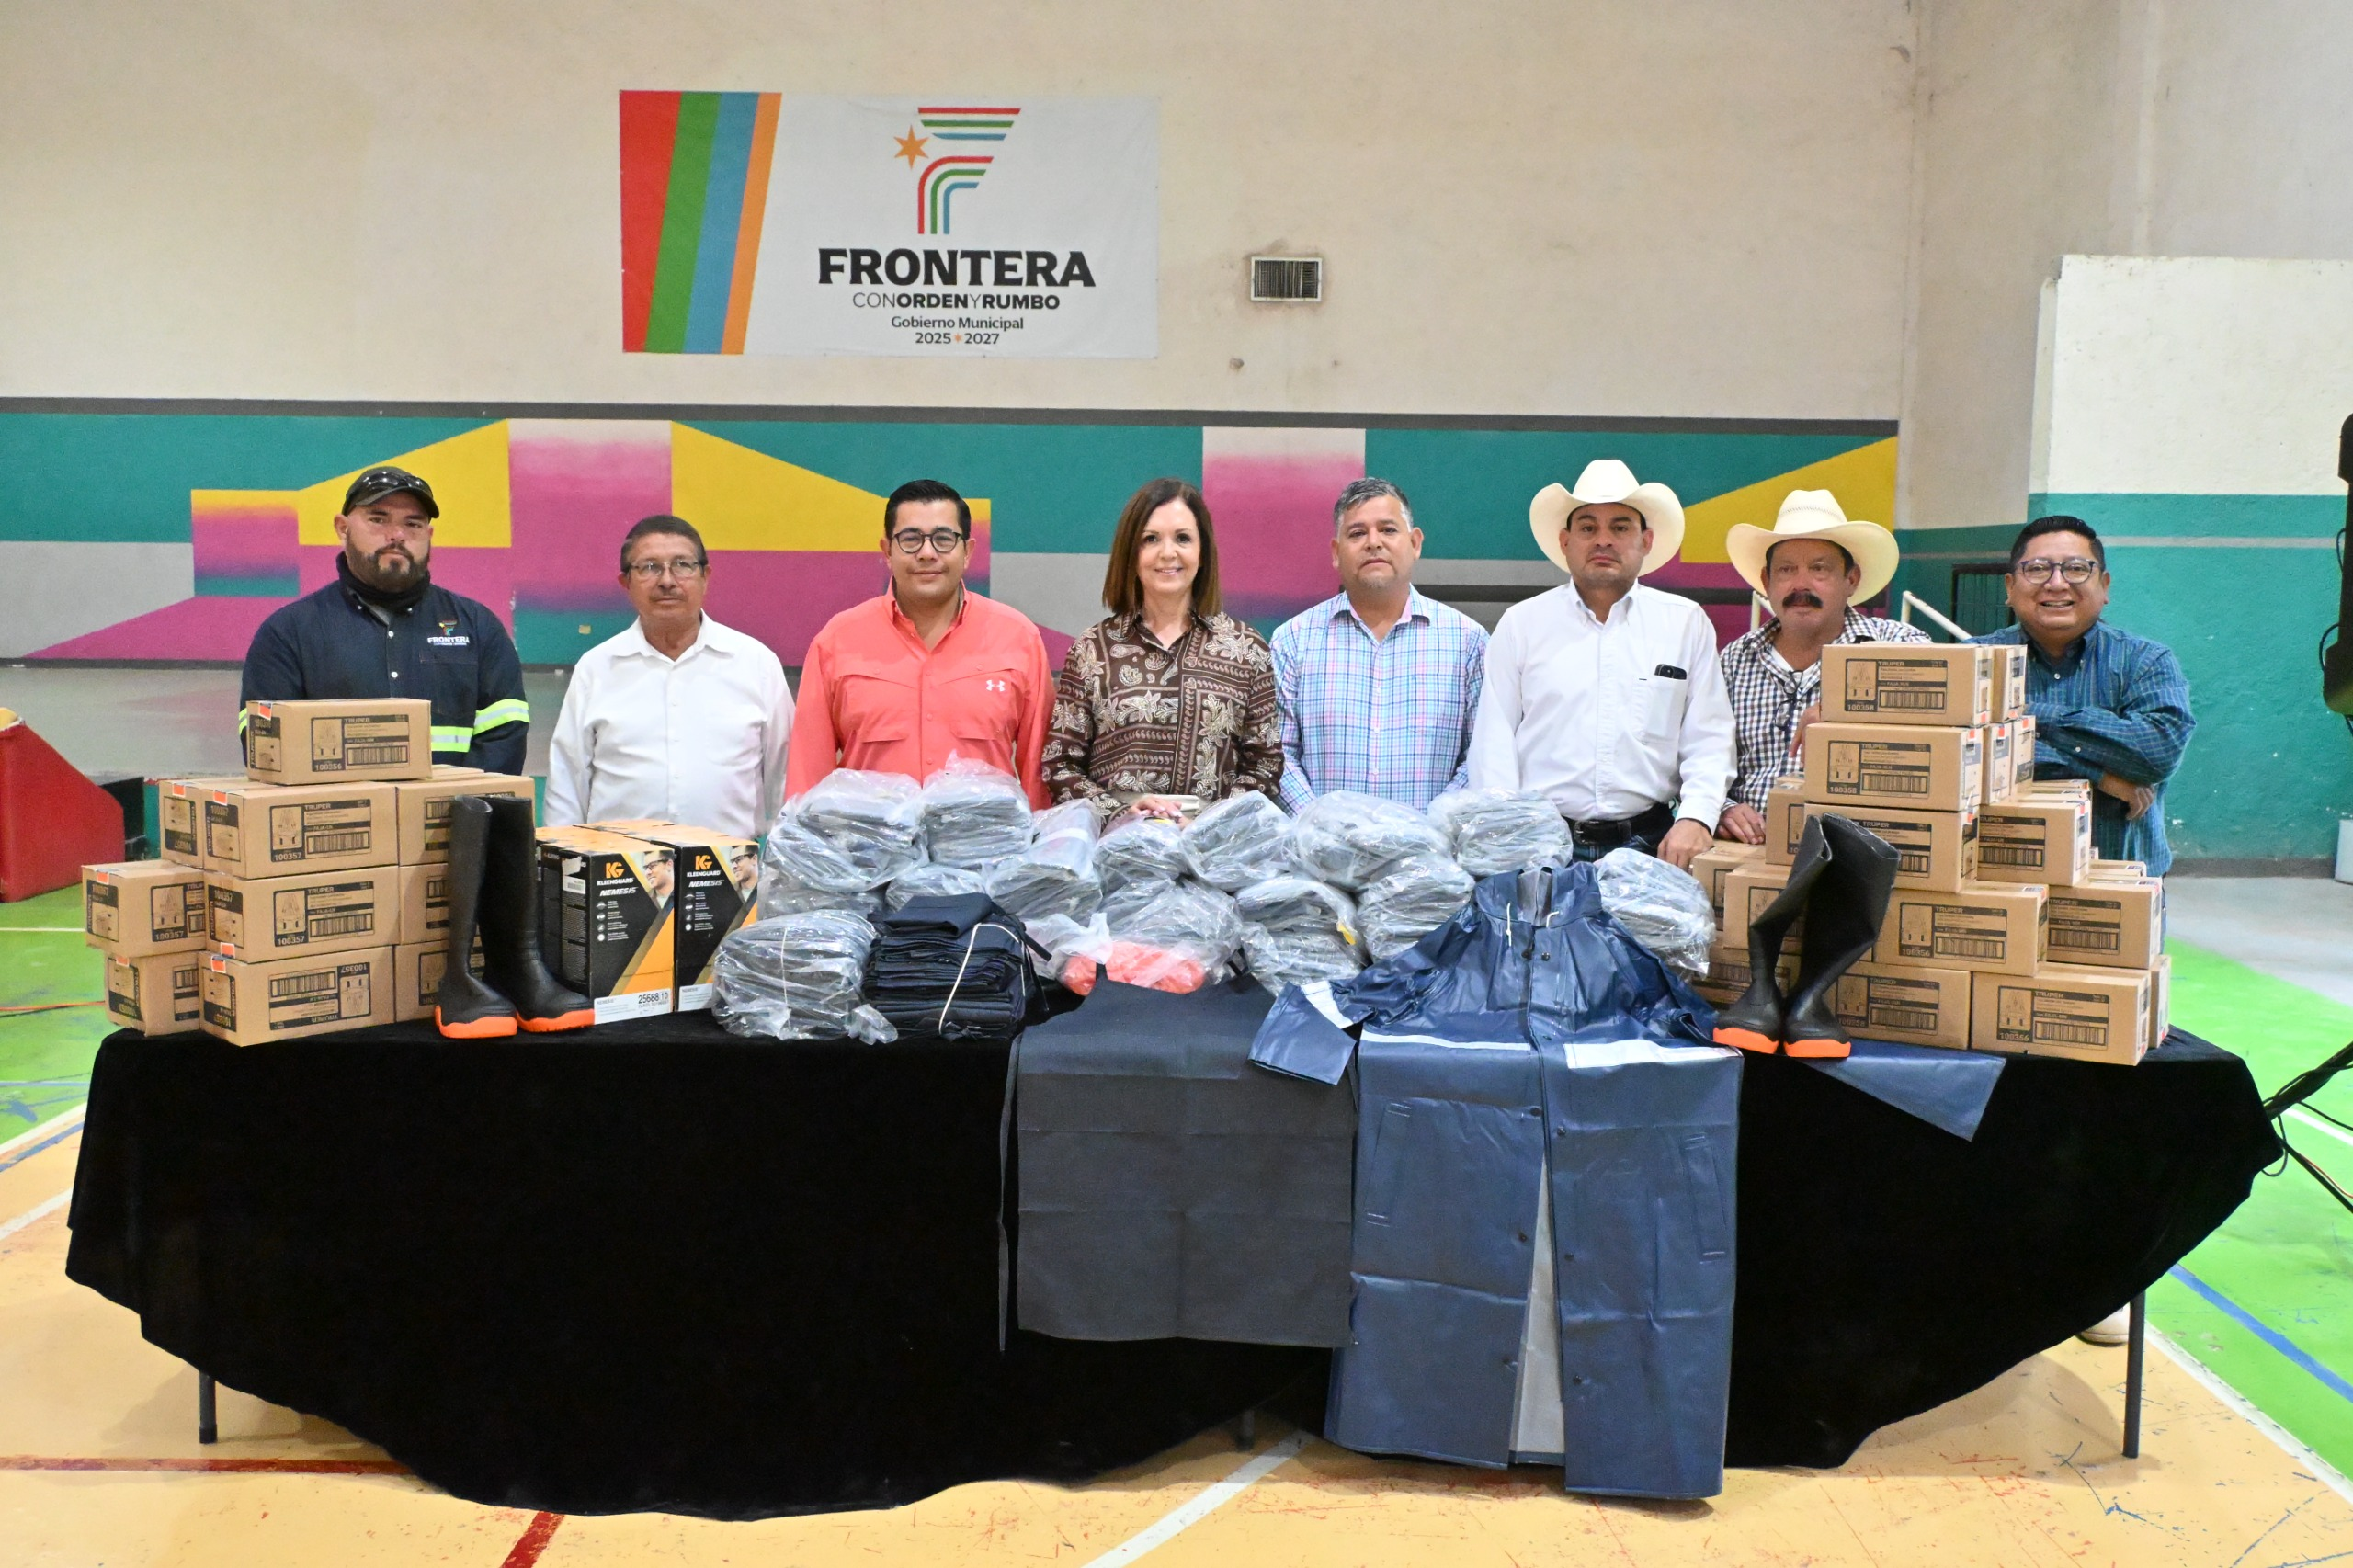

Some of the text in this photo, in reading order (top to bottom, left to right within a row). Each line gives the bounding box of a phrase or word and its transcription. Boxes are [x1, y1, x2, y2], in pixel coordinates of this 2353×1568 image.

[818, 248, 1097, 288] FRONTERA
[891, 315, 1024, 332] Gobierno Municipal
[915, 332, 1000, 345] 2025 2027
[426, 636, 470, 644] FRONTERA
[1847, 703, 1875, 711] 100358
[314, 762, 343, 771] 100356
[305, 802, 332, 811] TRUPER
[1979, 815, 2004, 824] RUPER
[274, 852, 302, 861] 100357
[686, 869, 722, 878] KLEENGUARD
[597, 877, 634, 886] KLEENGUARD
[688, 879, 723, 888] NEMESIS
[308, 886, 335, 895] TRUPER
[599, 886, 638, 897] NEMESIS
[1936, 906, 1964, 915] TRUPER
[155, 930, 184, 941] 100357
[277, 936, 305, 946] 100357
[340, 963, 368, 973] 100357
[638, 993, 659, 1005] 25688
[2034, 990, 2064, 999] TRUPER
[1999, 1032, 2029, 1042] 100356
